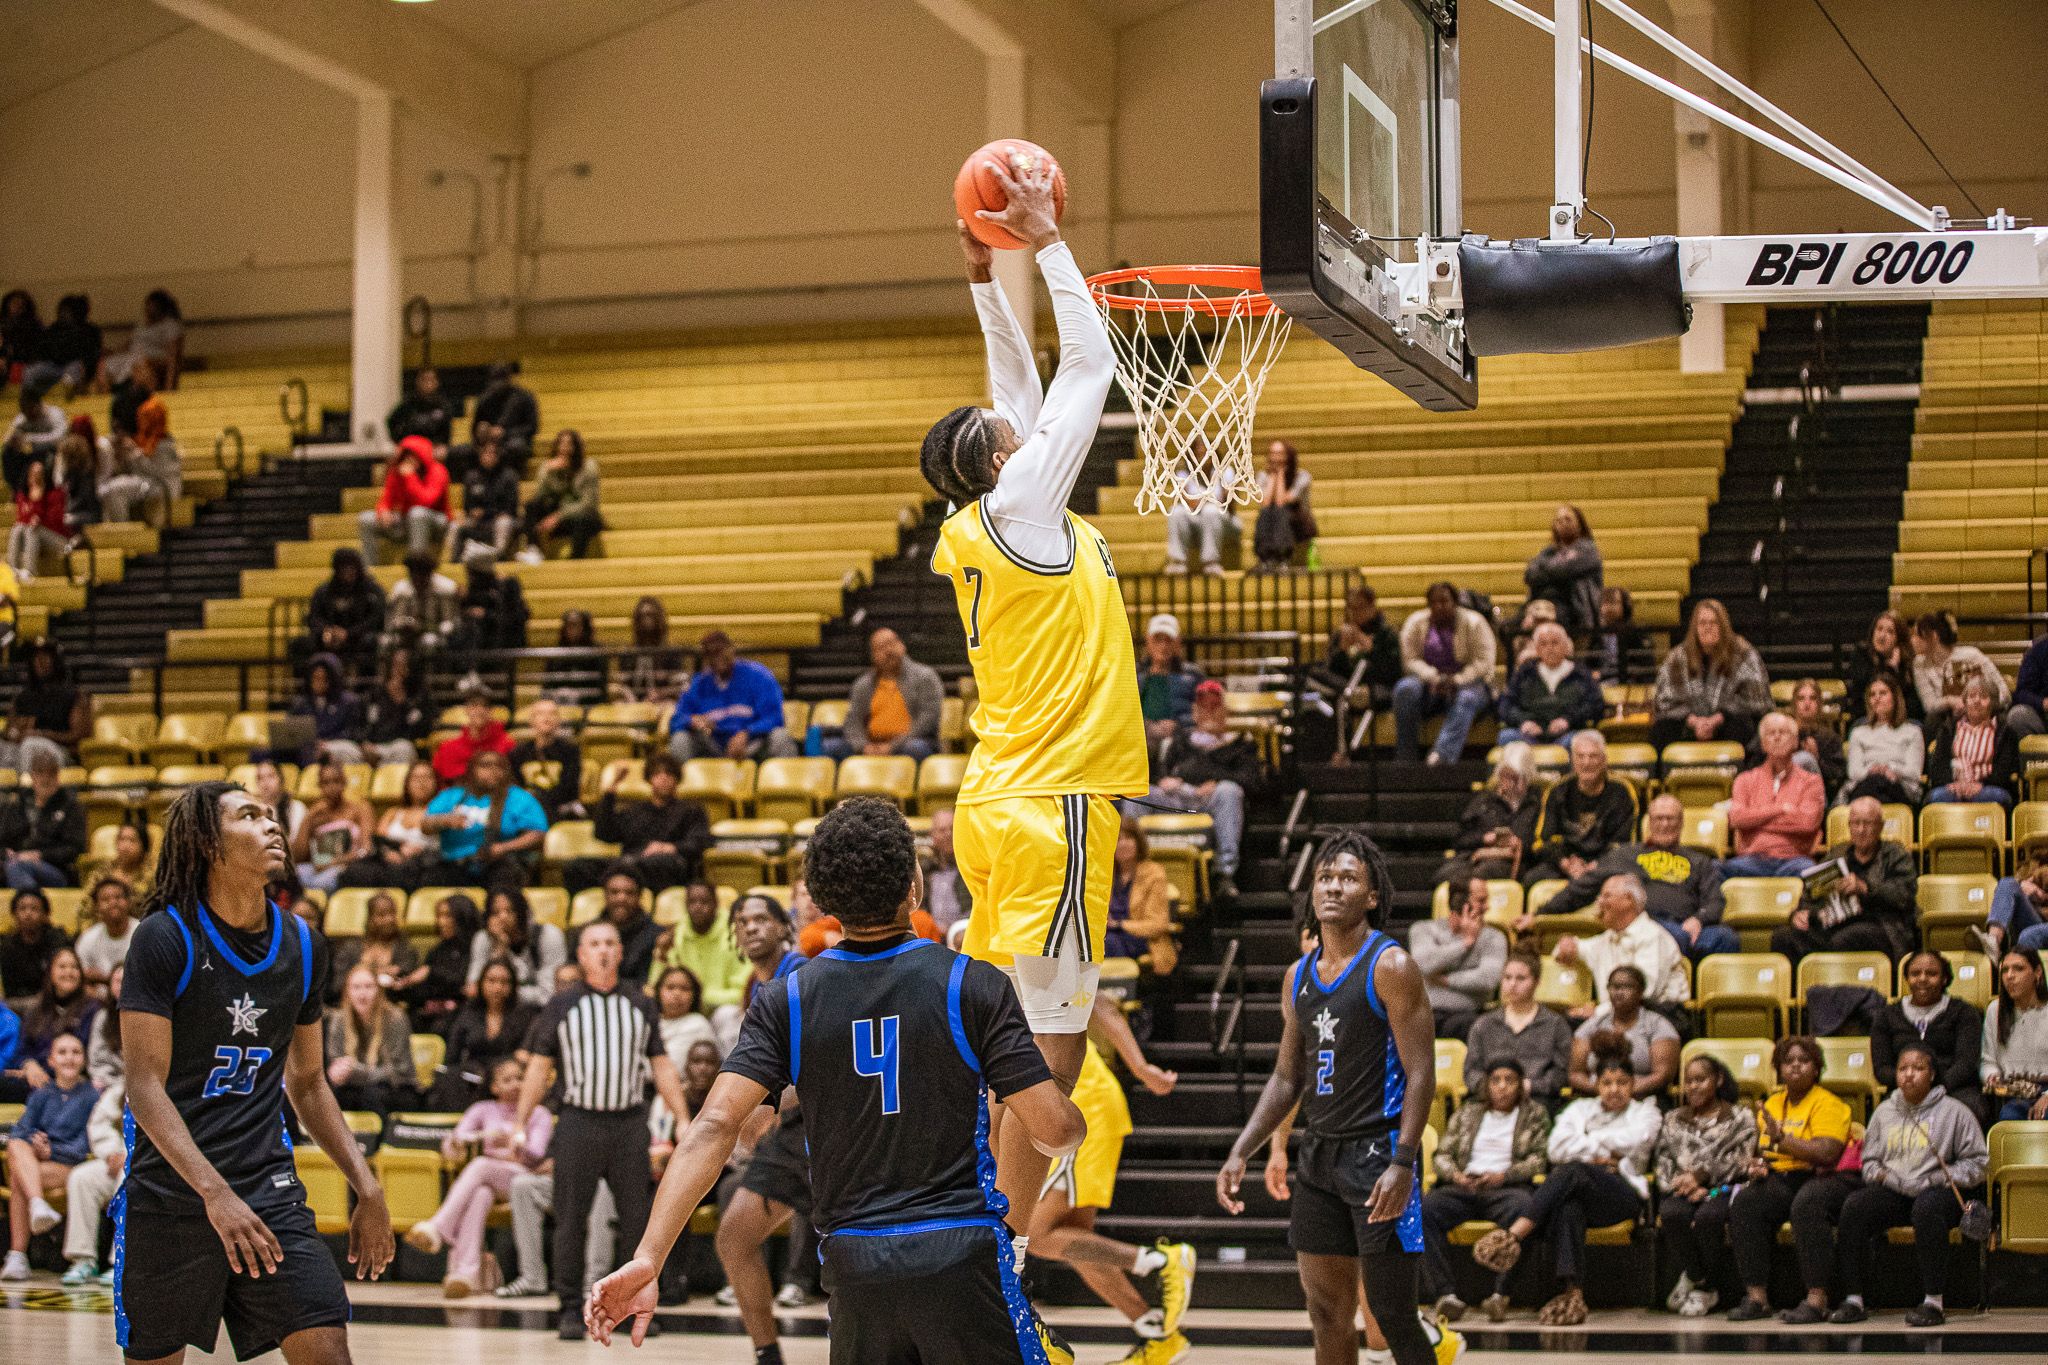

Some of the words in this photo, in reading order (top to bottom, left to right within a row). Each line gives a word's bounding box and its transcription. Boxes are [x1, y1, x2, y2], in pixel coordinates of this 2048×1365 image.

[1745, 242, 1848, 286] BPI
[1852, 240, 1975, 286] 8000
[963, 566, 982, 650] 7
[202, 1045, 273, 1099] 23
[852, 1015, 900, 1115] 4
[1317, 1050, 1335, 1096] 2
